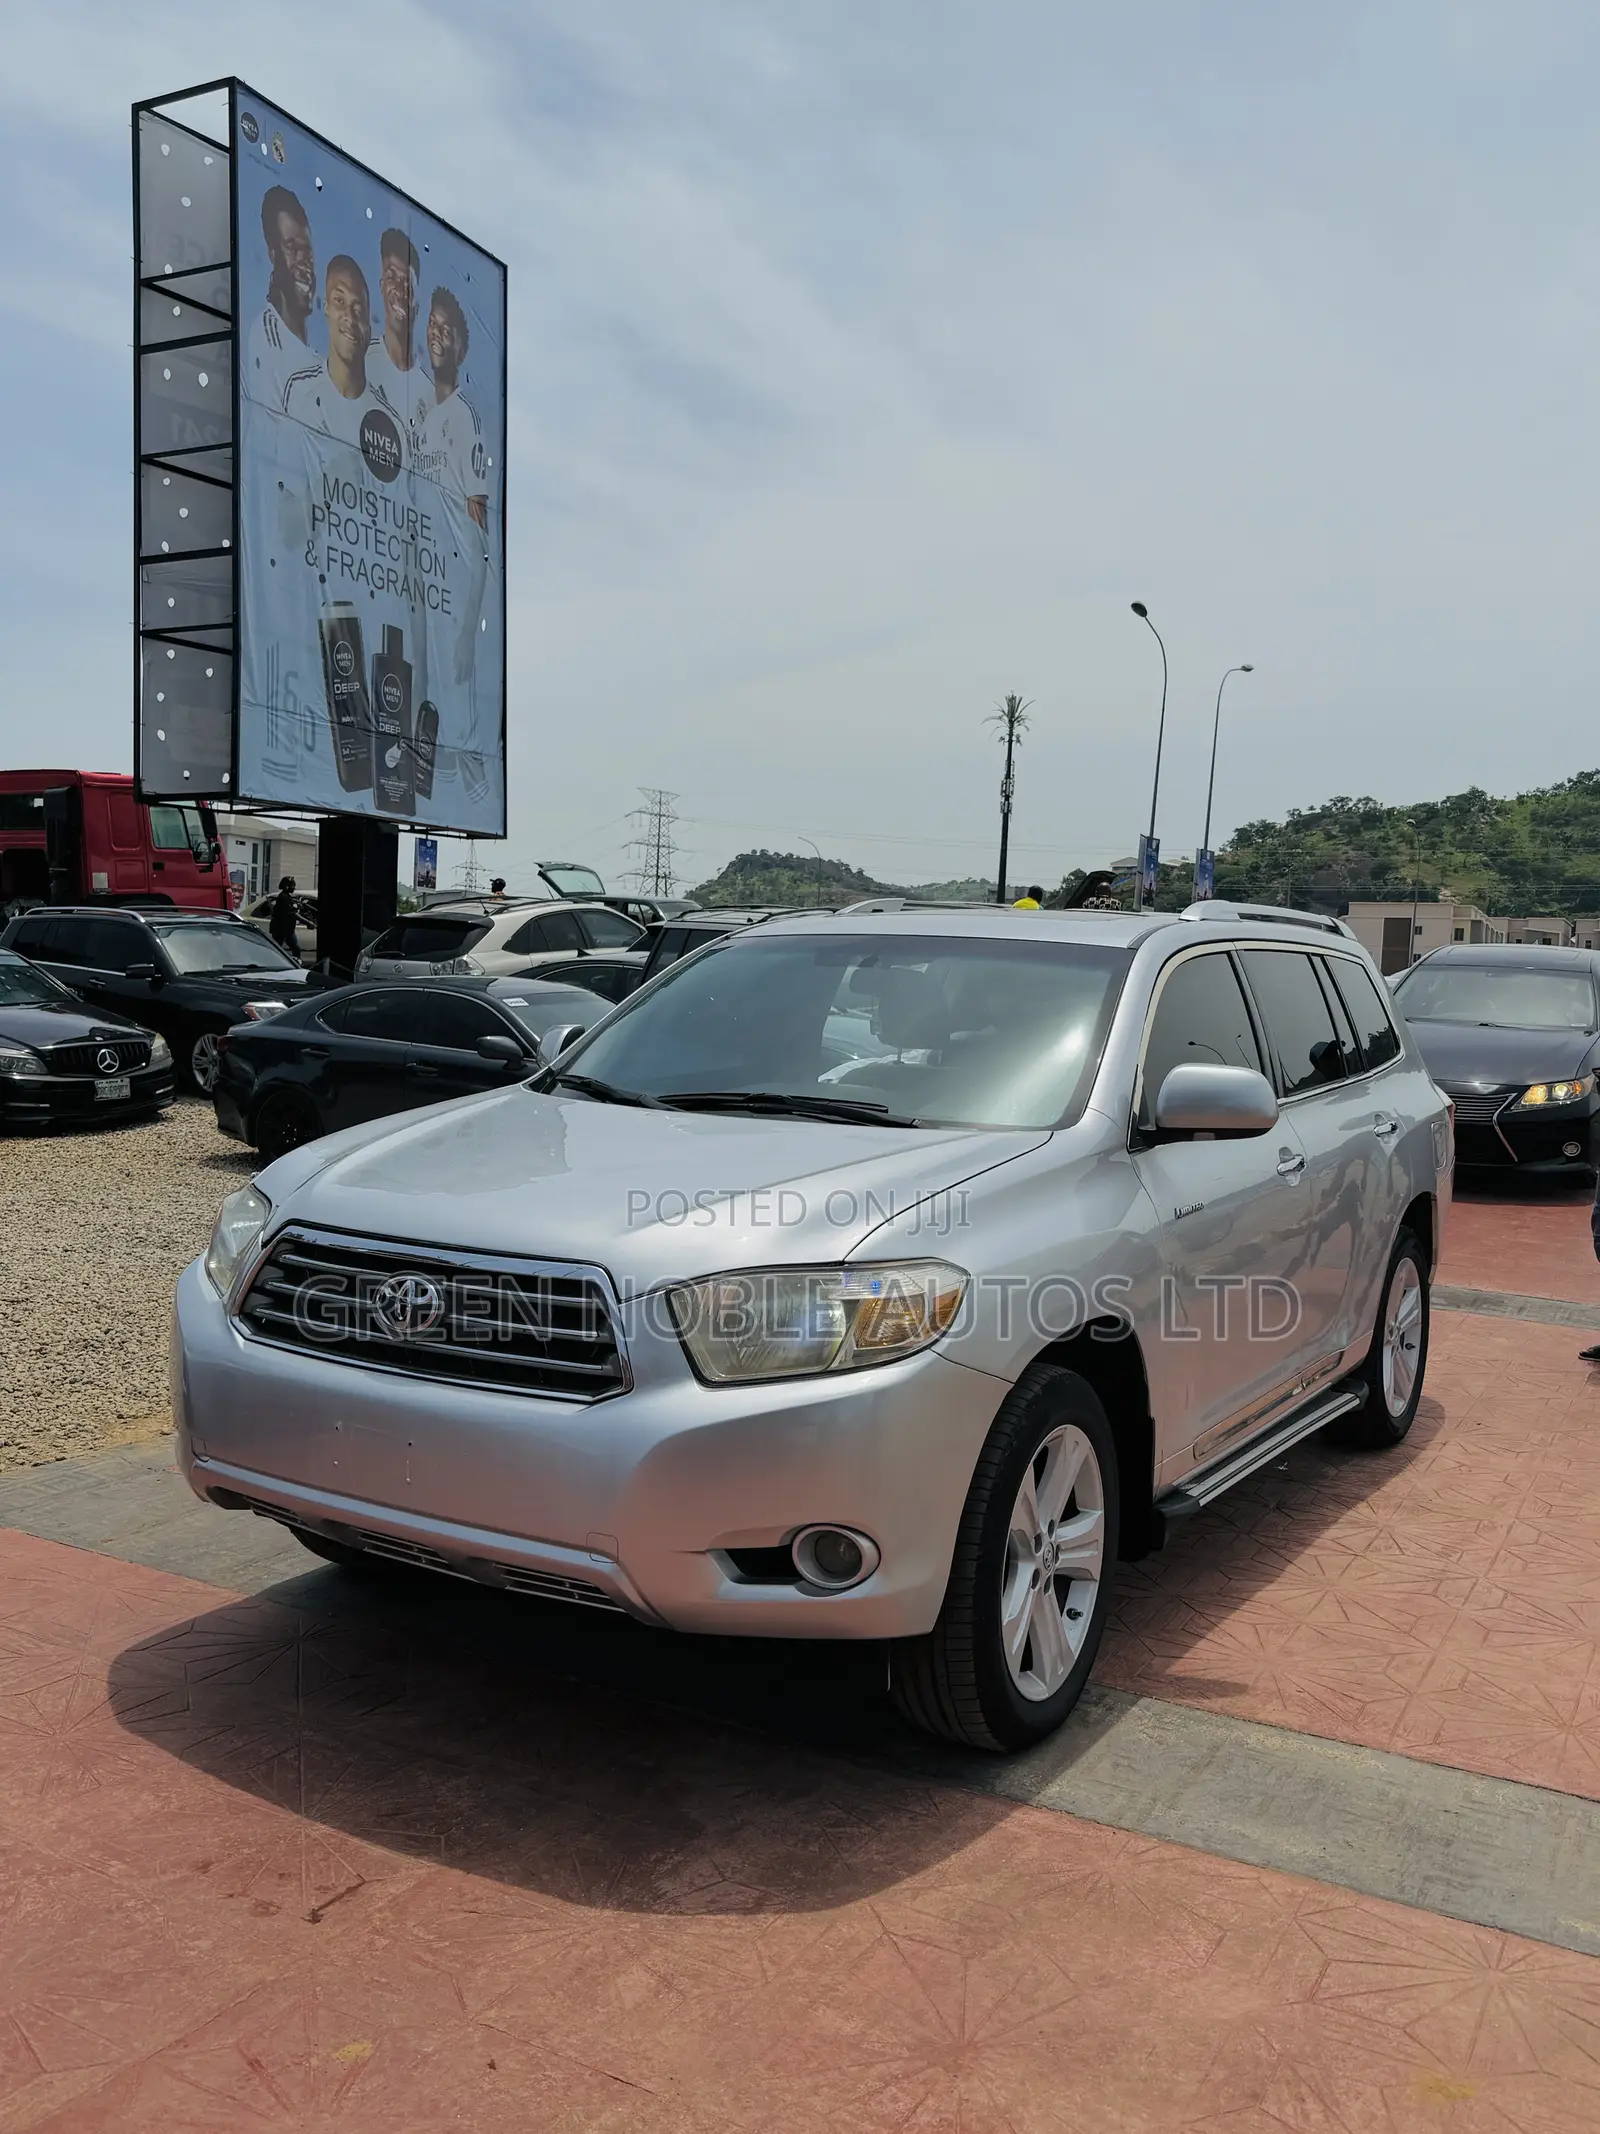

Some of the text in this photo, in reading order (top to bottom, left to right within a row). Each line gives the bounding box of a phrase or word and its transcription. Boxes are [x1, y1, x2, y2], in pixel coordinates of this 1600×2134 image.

[364, 427, 399, 457] NIVEA
[368, 447, 395, 469] MEN
[323, 472, 436, 548] MOISTURE,
[312, 504, 446, 580] PROTECTION
[305, 539, 452, 616] & FRAGRANCE
[334, 682, 361, 694] DEEP
[384, 686, 401, 697] NIVEA
[380, 722, 401, 735] DEEP
